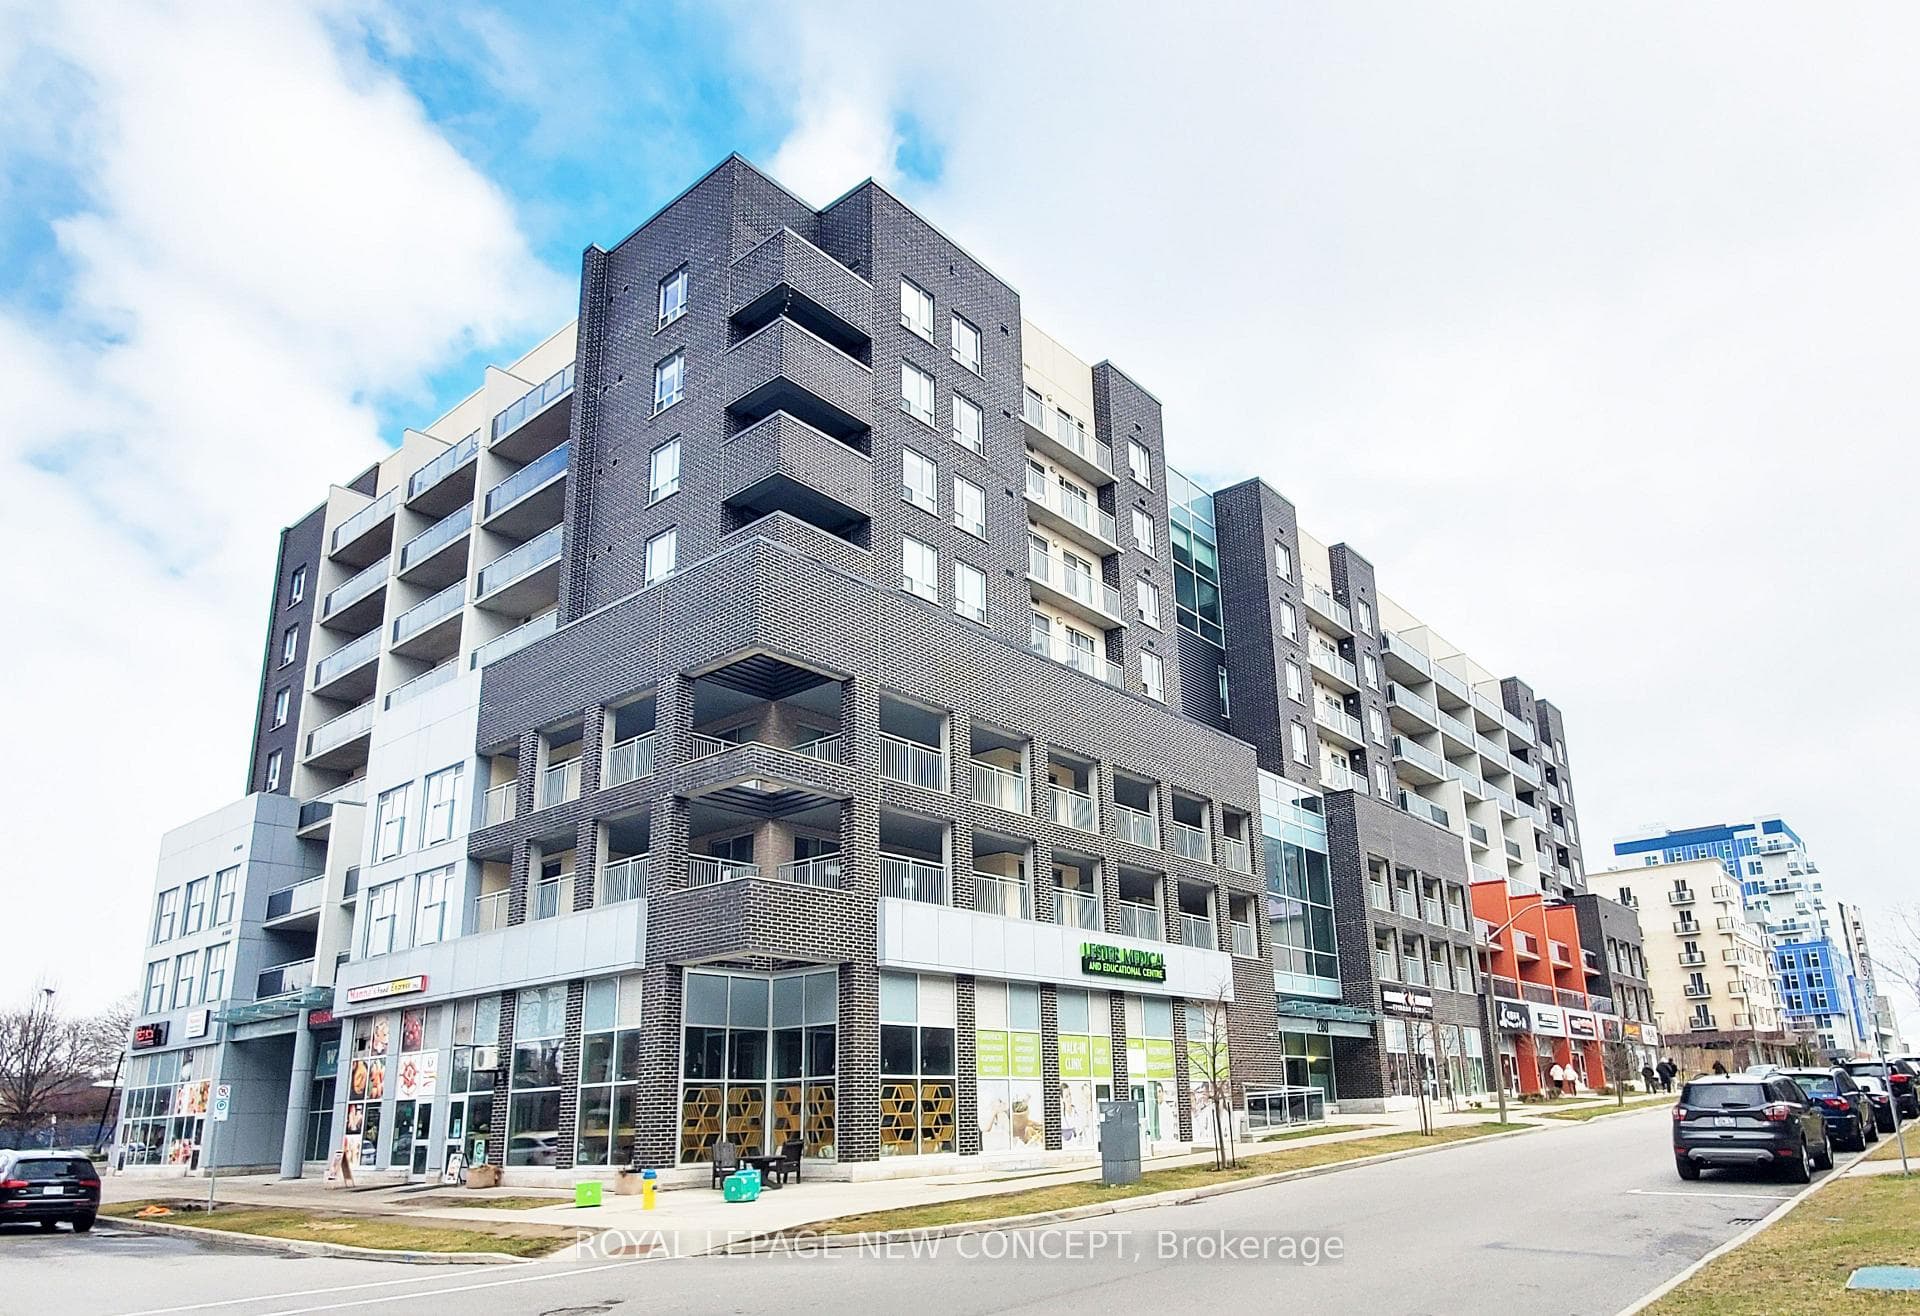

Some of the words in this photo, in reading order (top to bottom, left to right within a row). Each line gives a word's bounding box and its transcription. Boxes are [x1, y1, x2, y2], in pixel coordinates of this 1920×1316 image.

[1121, 947, 1166, 967] MEDICAL
[1089, 961, 1101, 971] AND
[1102, 963, 1142, 976] EDUCATIONAL
[1142, 968, 1164, 979] CENTRE
